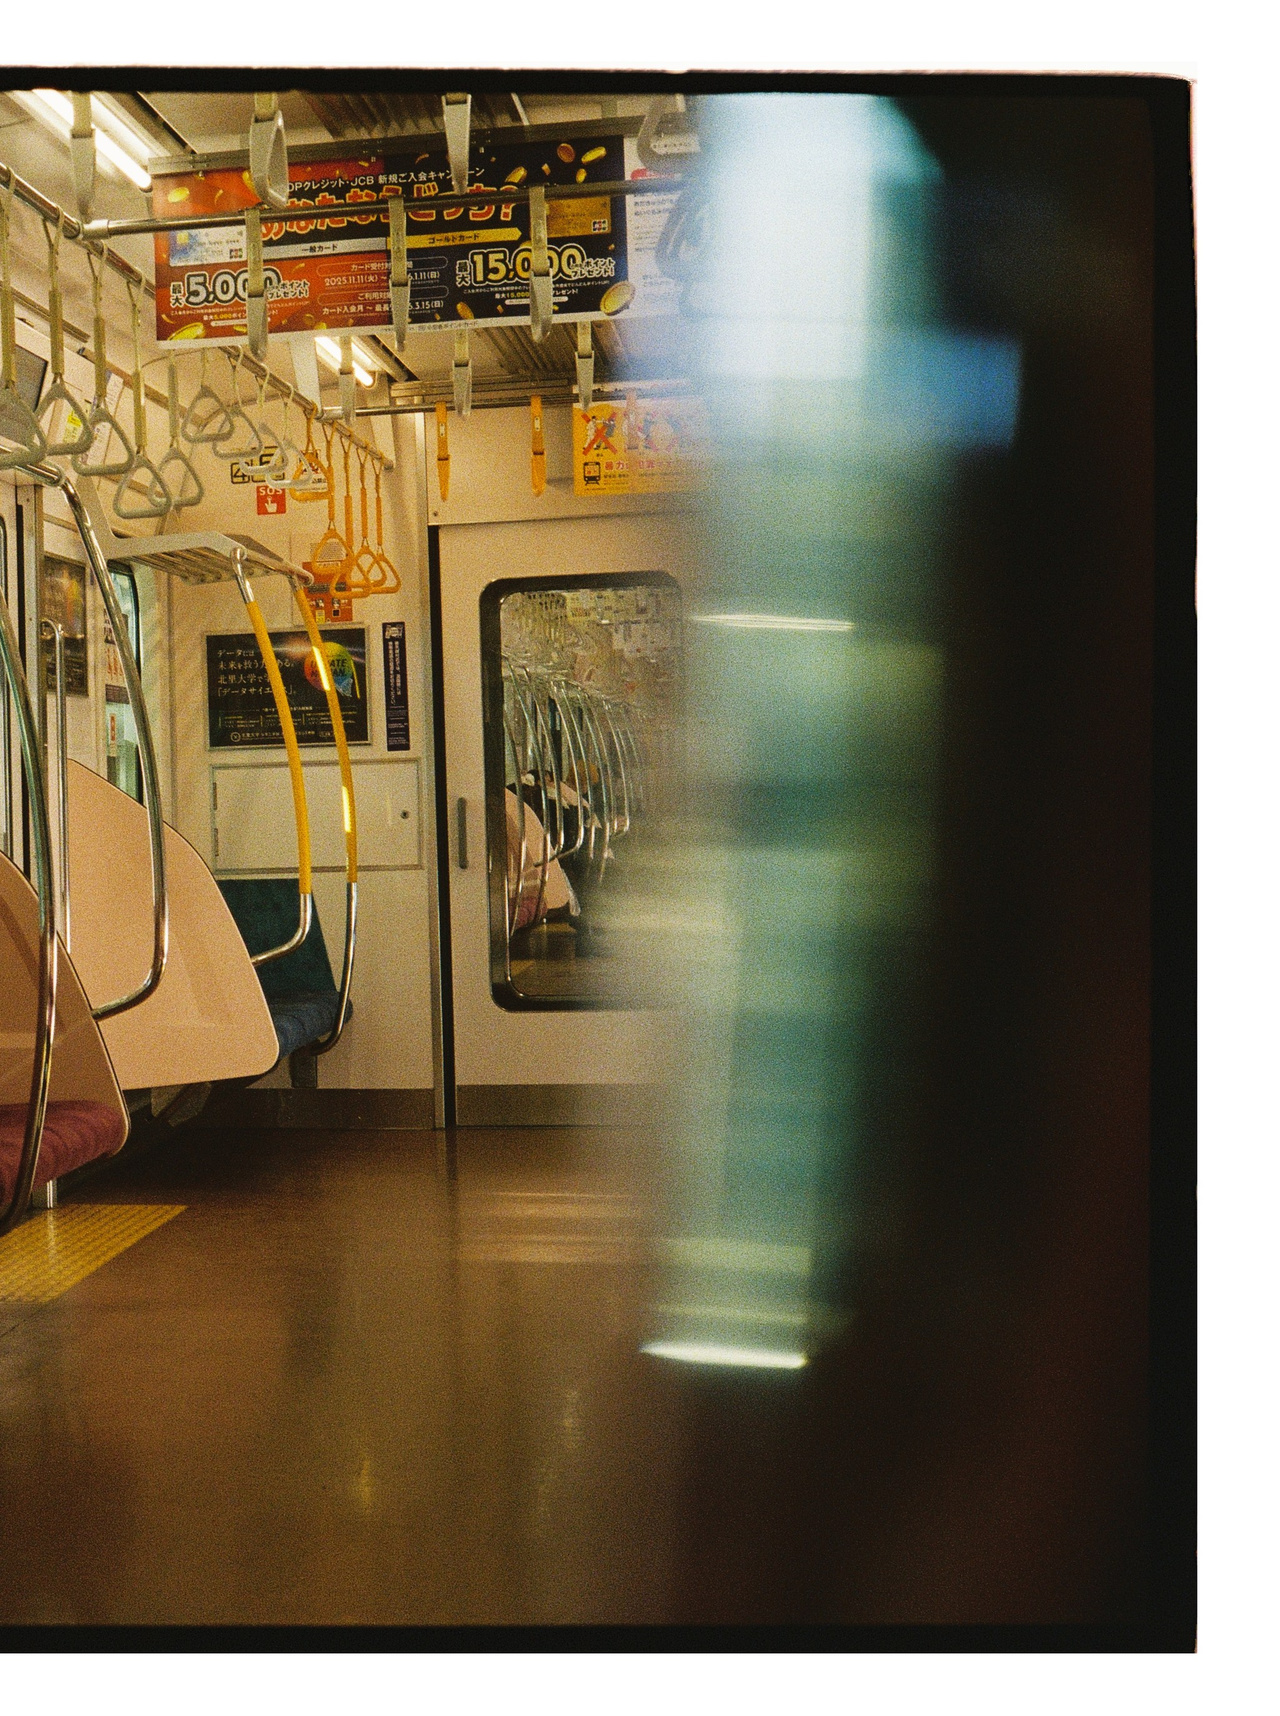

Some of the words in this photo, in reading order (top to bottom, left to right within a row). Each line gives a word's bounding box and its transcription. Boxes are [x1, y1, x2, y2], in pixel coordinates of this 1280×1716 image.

[378, 168, 485, 184] 新規ご入会キャンーン
[428, 233, 480, 244] ゴールドカード
[301, 243, 339, 254] 一般カード
[350, 260, 414, 272] カード受付対間
[456, 260, 470, 286] 最大
[171, 282, 184, 307] 最大
[259, 486, 283, 496] SOS
[217, 649, 255, 657] データには
[217, 673, 271, 684] 北里大学で学
[217, 684, 297, 697] 「データサイエ」。
